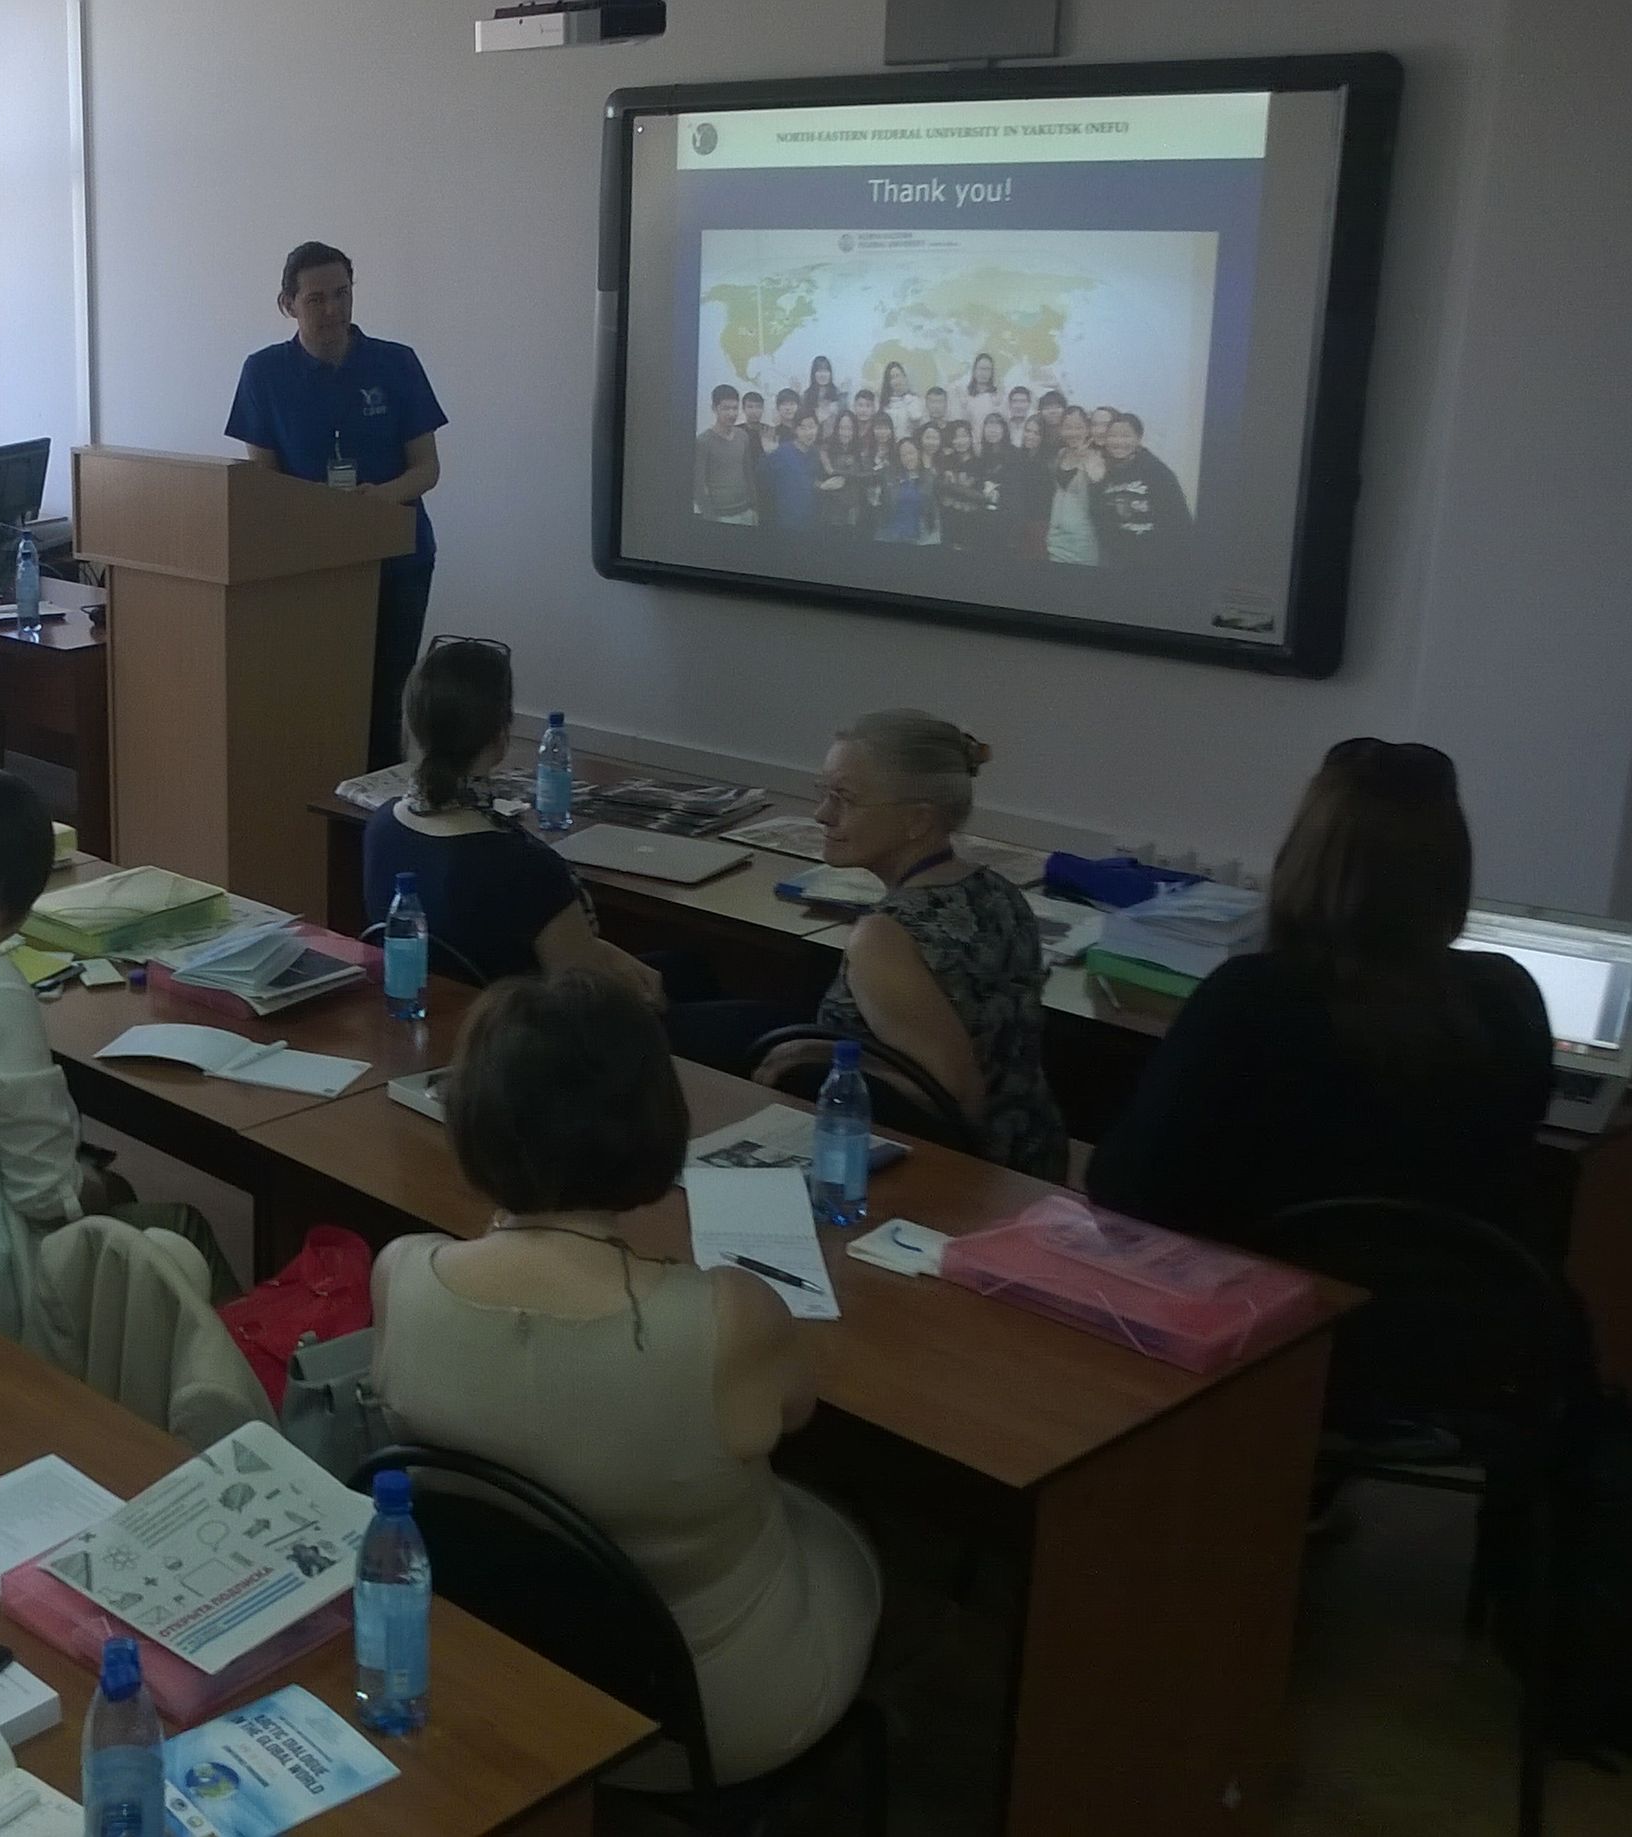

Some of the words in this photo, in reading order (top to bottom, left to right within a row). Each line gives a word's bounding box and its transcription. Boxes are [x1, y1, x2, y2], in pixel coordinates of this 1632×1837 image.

[871, 127, 922, 141] FEDERAL
[926, 125, 1000, 139] UNIVERSITY
[1003, 124, 1018, 137] IN
[1021, 122, 1083, 136] YAKUTSK
[868, 177, 946, 203] Thank
[955, 176, 1012, 209] you!
